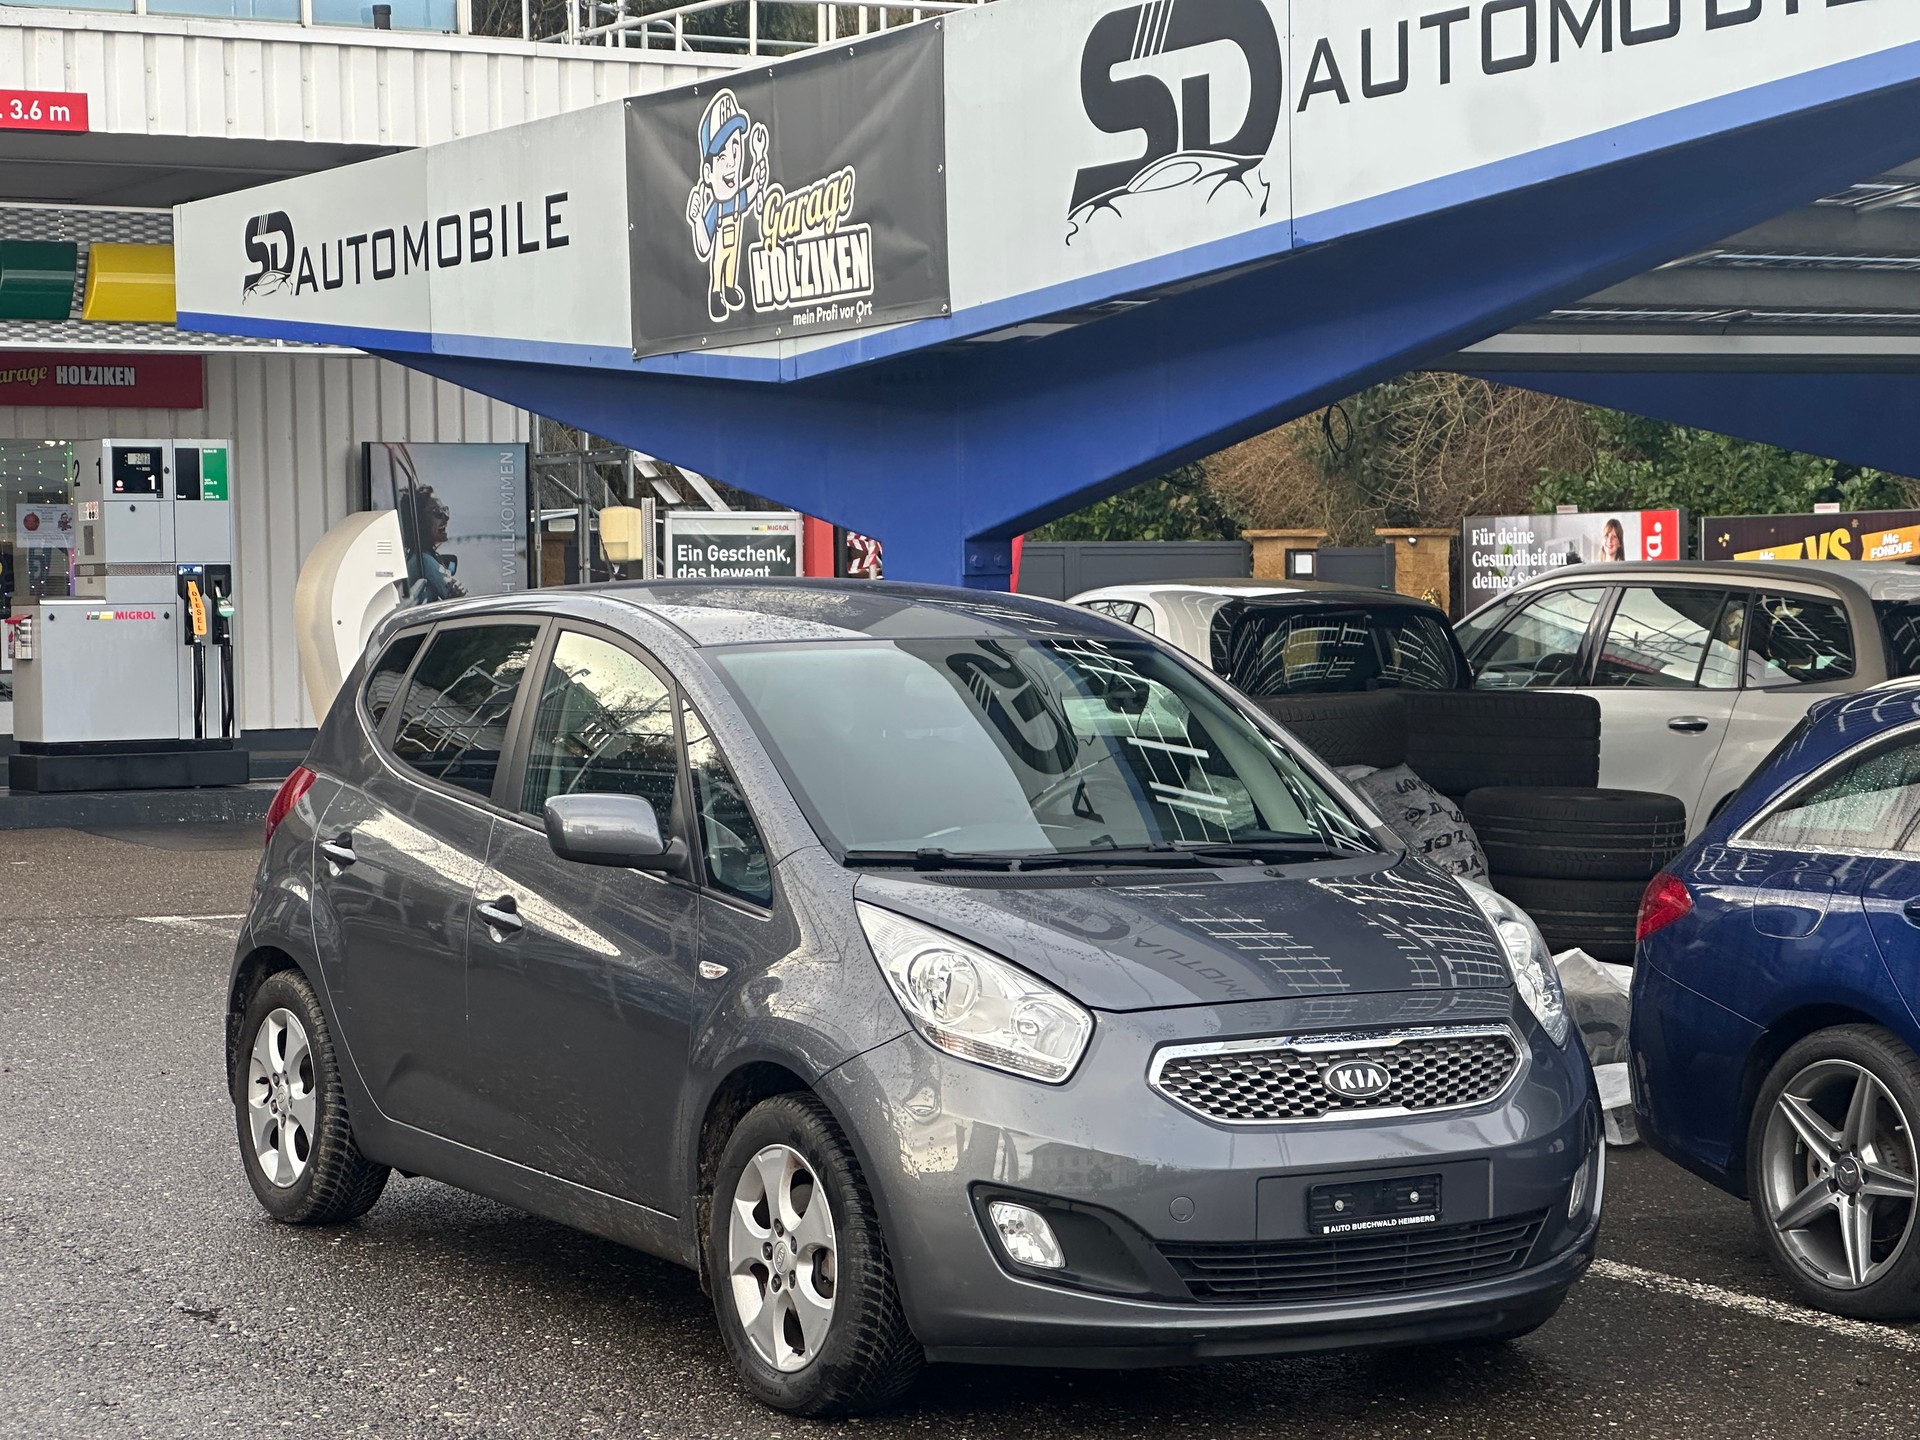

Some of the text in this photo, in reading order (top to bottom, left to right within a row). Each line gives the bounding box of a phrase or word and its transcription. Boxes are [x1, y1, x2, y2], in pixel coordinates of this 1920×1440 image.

[1296, 0, 1869, 113] AUTOMO
[9, 98, 71, 122] 3.6 m
[761, 168, 853, 255] Garage
[243, 190, 570, 297] SD AUTOMOBILE
[751, 230, 870, 305] HOLZIKEN
[792, 302, 873, 326] mein Profi vor Ort
[56, 365, 136, 386] HOLZIKEN
[73, 459, 81, 487] 2
[95, 457, 102, 485] 1
[147, 474, 156, 490] 1
[500, 451, 516, 577] WILLKOMMEN
[1471, 526, 1535, 547] Für deine
[1804, 527, 1851, 561] VS
[1881, 533, 1900, 546] Mc
[677, 543, 791, 565] Ein Geschenk,
[1472, 547, 1568, 568] Gesundheit an
[1870, 540, 1914, 560] FONDUE
[676, 564, 706, 577] das
[1472, 569, 1516, 590] deiner
[114, 610, 157, 621] MIGROL
[190, 590, 204, 632] DIESEL
[1336, 1068, 1383, 1090] KIA
[1330, 1214, 1436, 1233] AUTO BUECHWALD HEIMBERG
